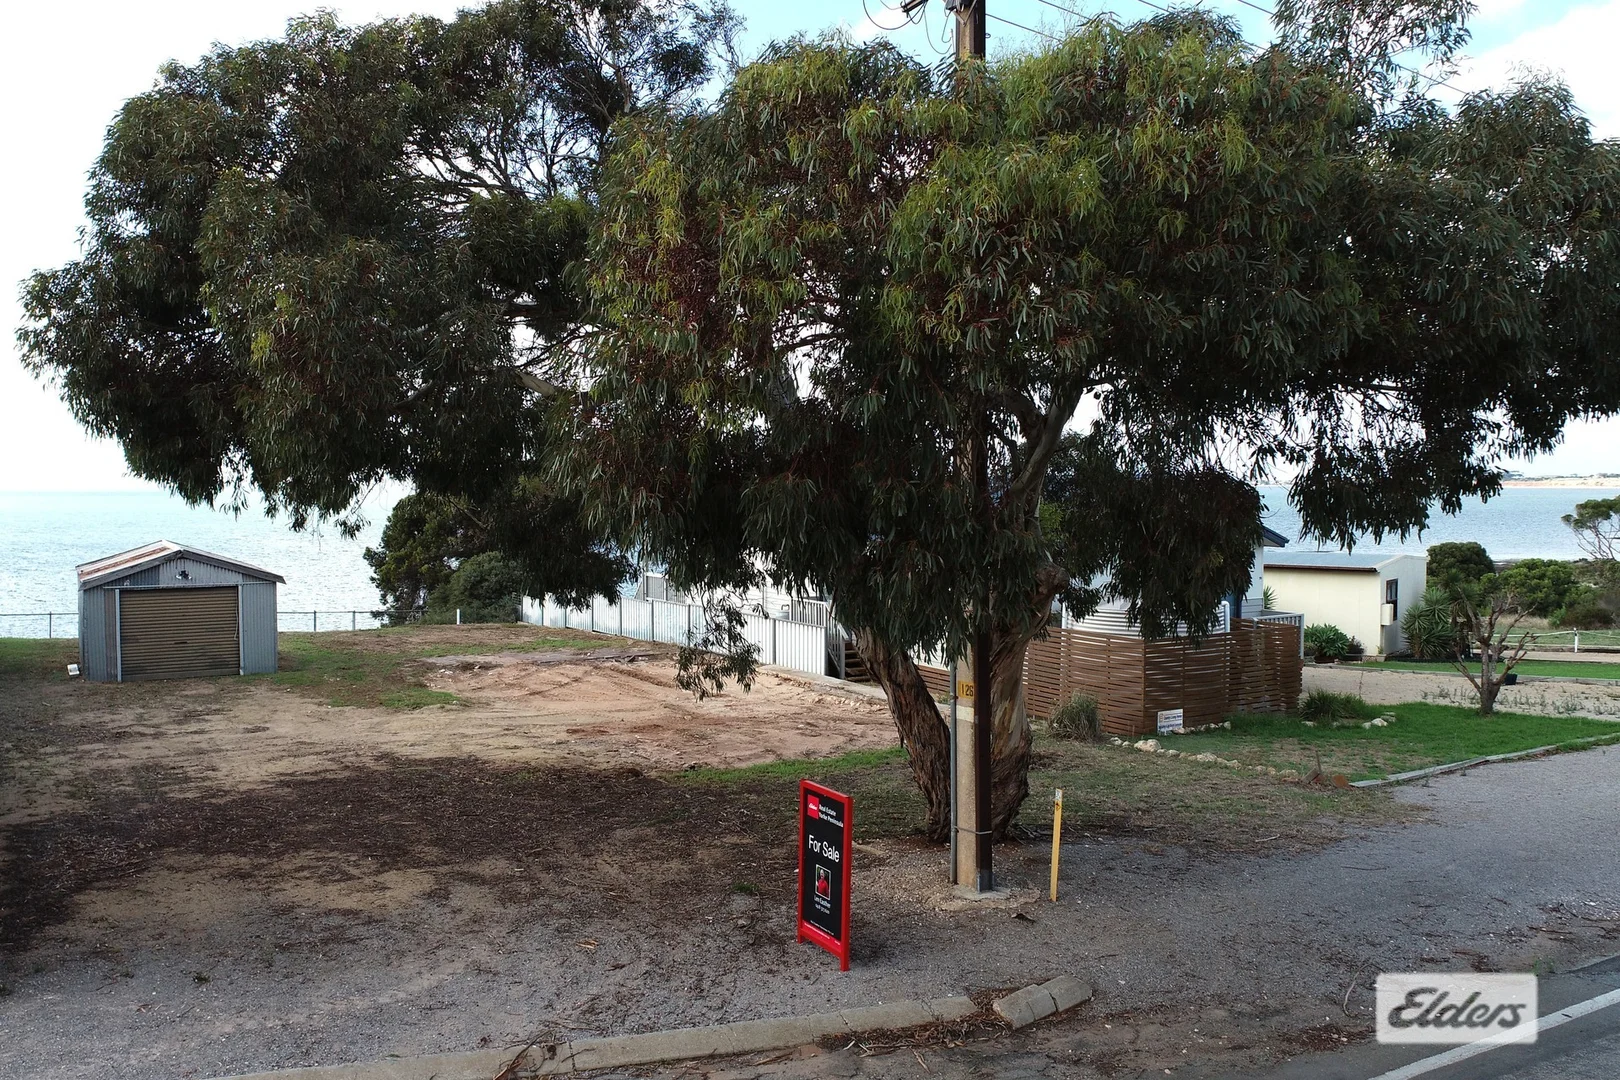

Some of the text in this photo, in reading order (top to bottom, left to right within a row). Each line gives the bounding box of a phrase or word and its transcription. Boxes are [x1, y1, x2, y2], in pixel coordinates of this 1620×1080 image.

[961, 683, 974, 697] 126
[808, 834, 840, 863] For Sale
